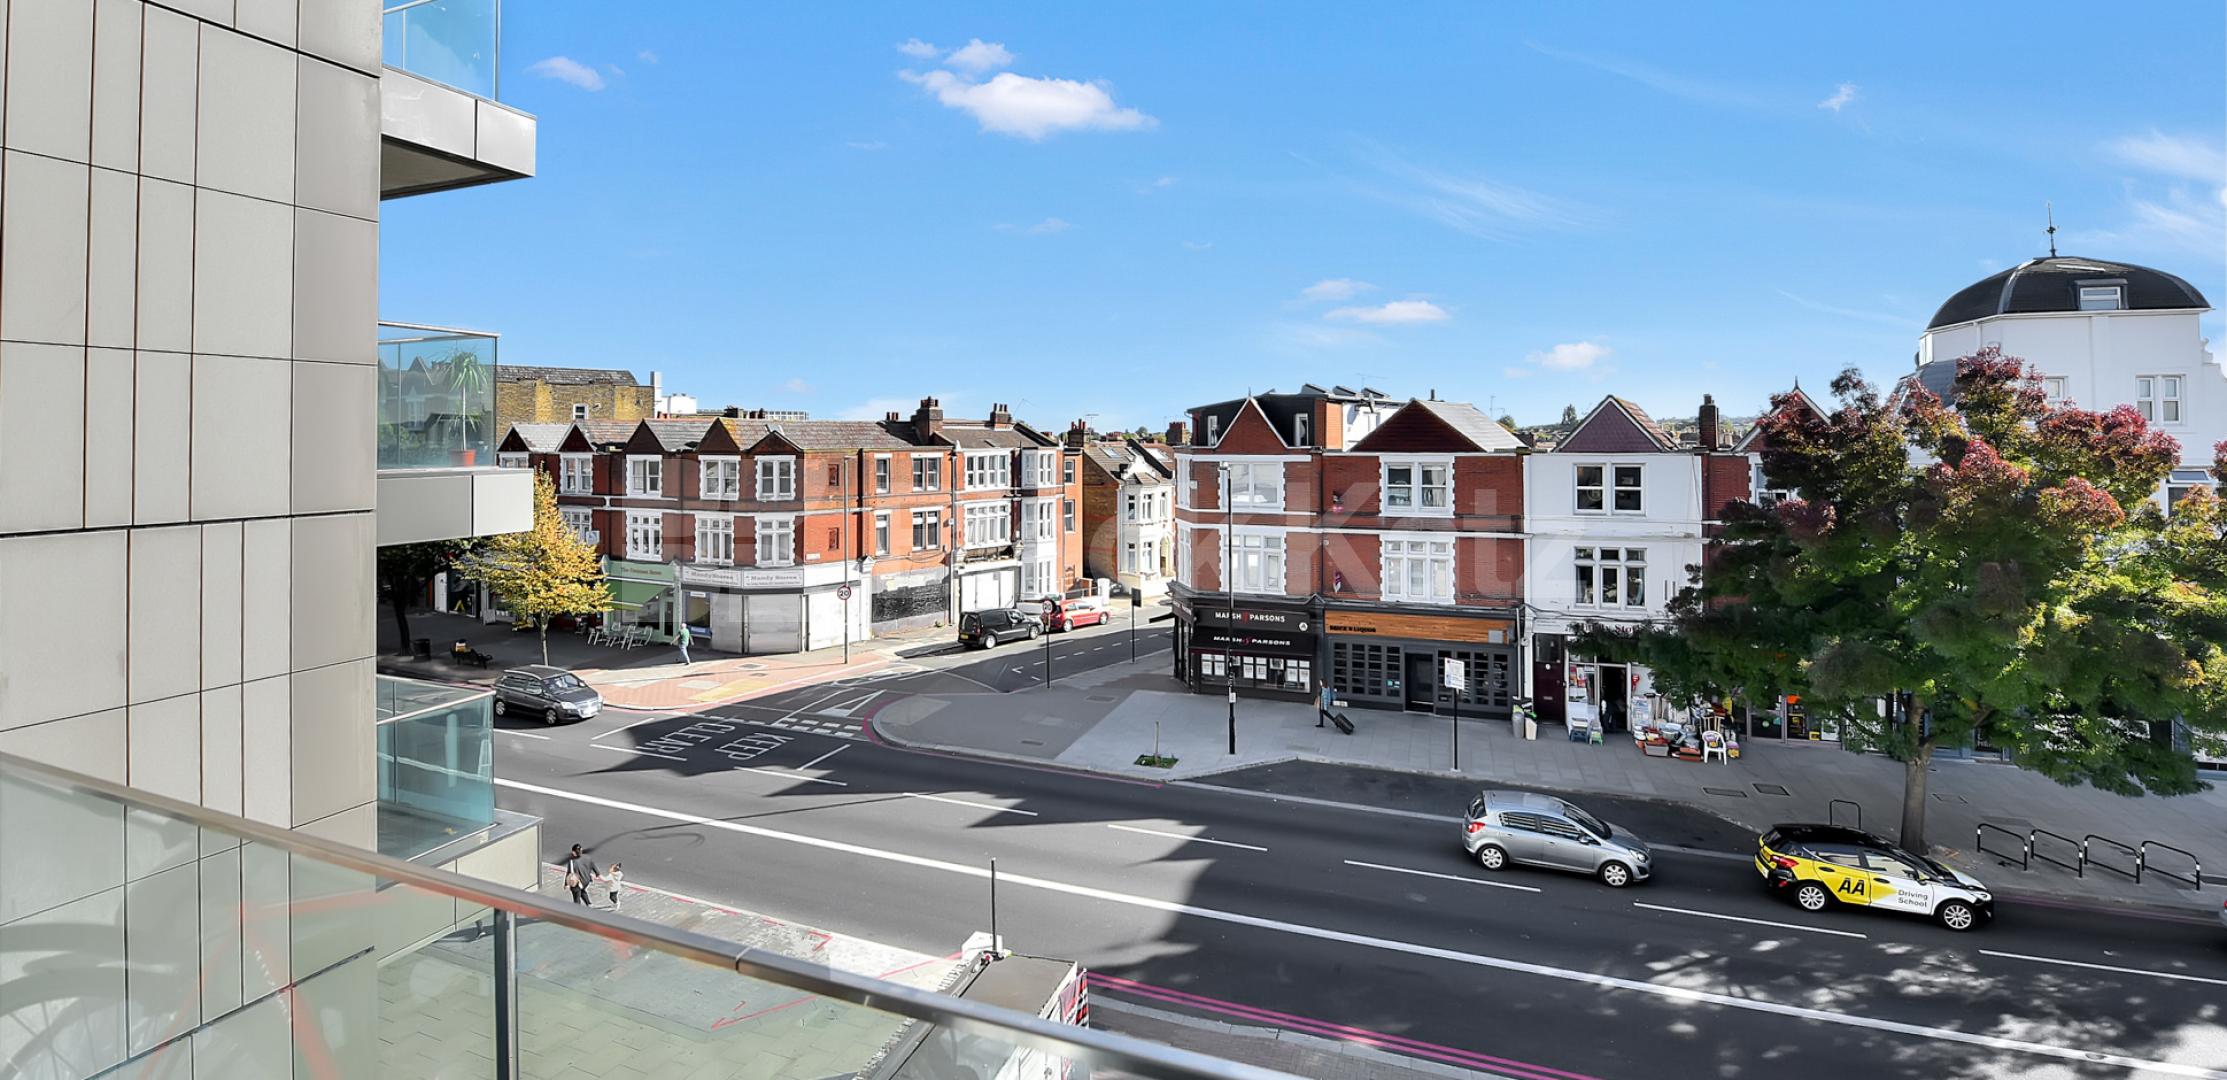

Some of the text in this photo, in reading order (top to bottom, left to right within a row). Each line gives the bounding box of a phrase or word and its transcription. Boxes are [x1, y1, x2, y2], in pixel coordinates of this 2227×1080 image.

[1249, 613, 1285, 623] PARSONS
[1251, 638, 1291, 646] PARSONS
[635, 721, 736, 754] CLEAR
[714, 732, 795, 760] KEEP
[1838, 877, 1865, 896] AA
[1898, 889, 1928, 900] Driving
[1898, 898, 1928, 908] School
